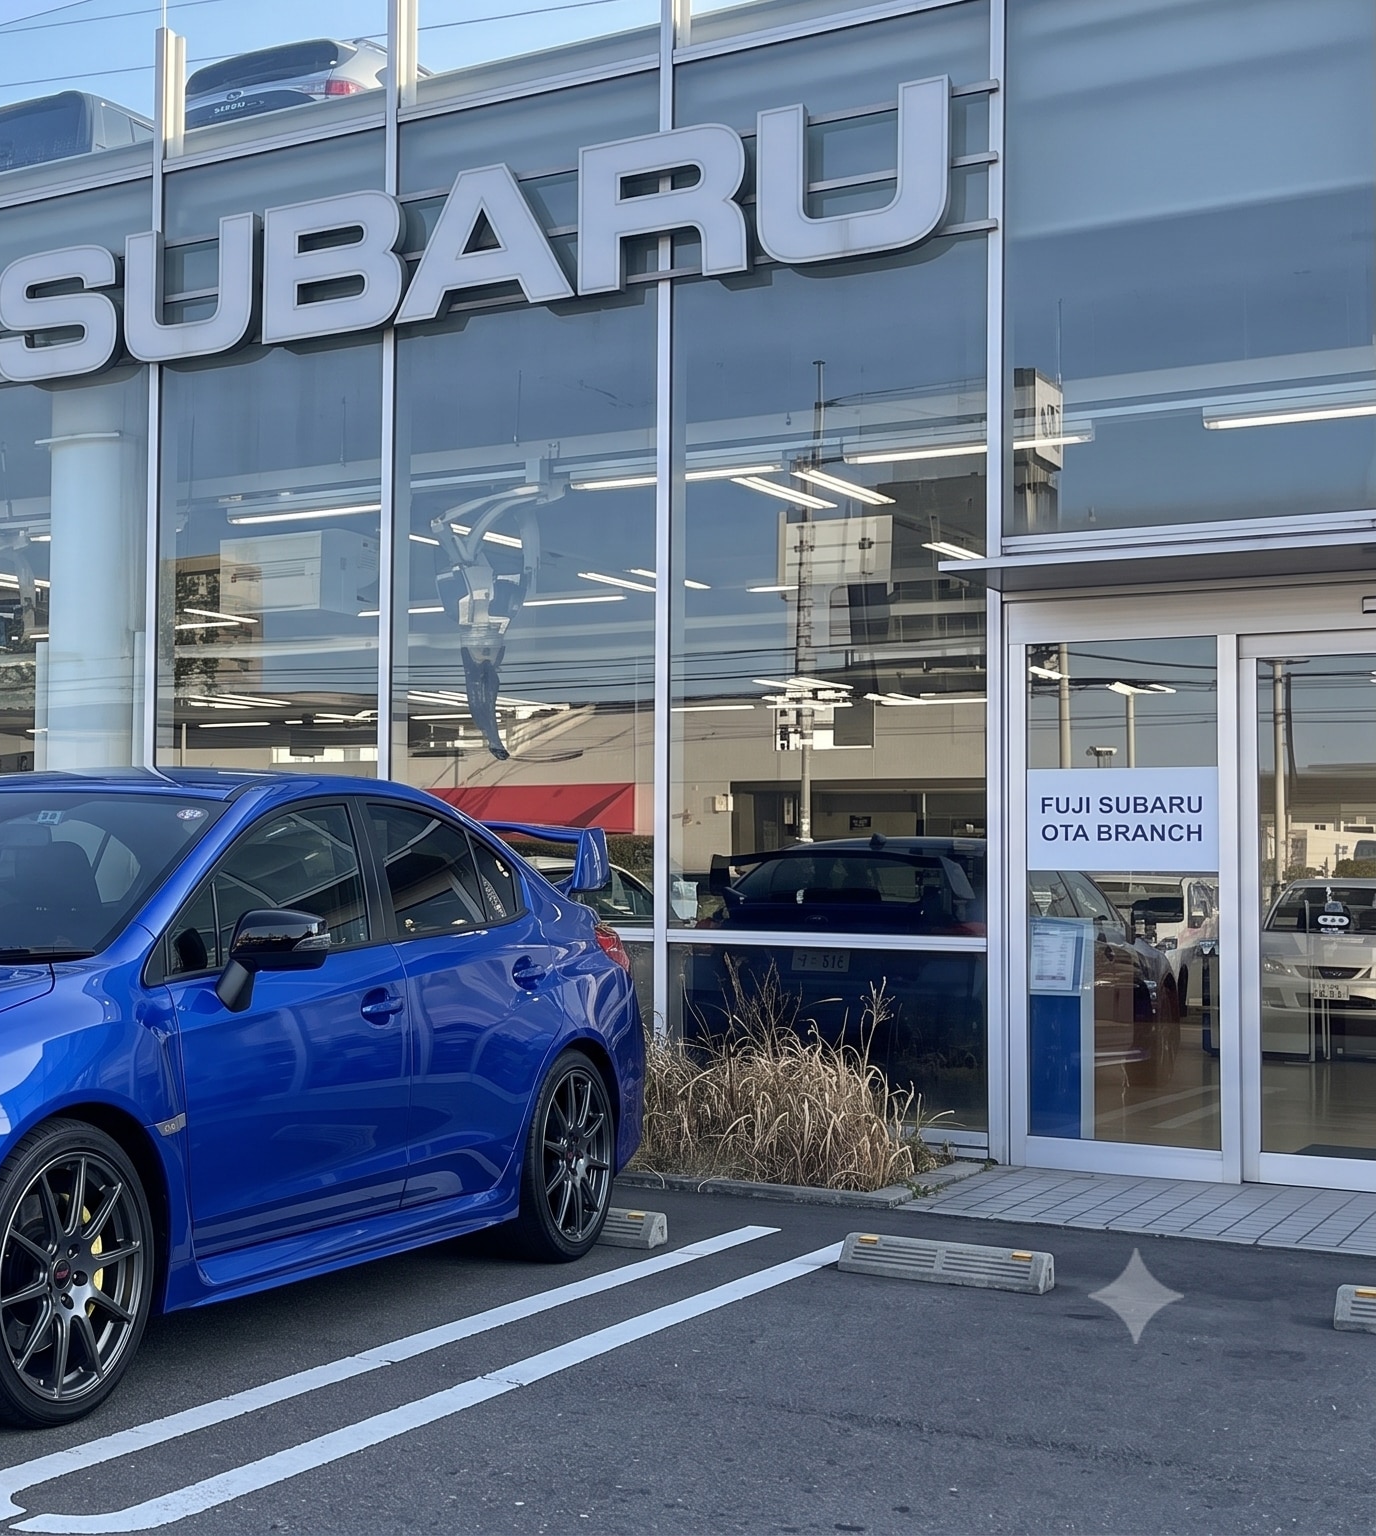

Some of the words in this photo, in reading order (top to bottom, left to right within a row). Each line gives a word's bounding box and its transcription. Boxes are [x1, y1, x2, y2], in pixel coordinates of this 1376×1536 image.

[1041, 796, 1091, 814] FUJI
[1098, 795, 1204, 814] SUBARU
[1041, 824, 1090, 842] OTA
[1097, 824, 1203, 842] BRANCH
